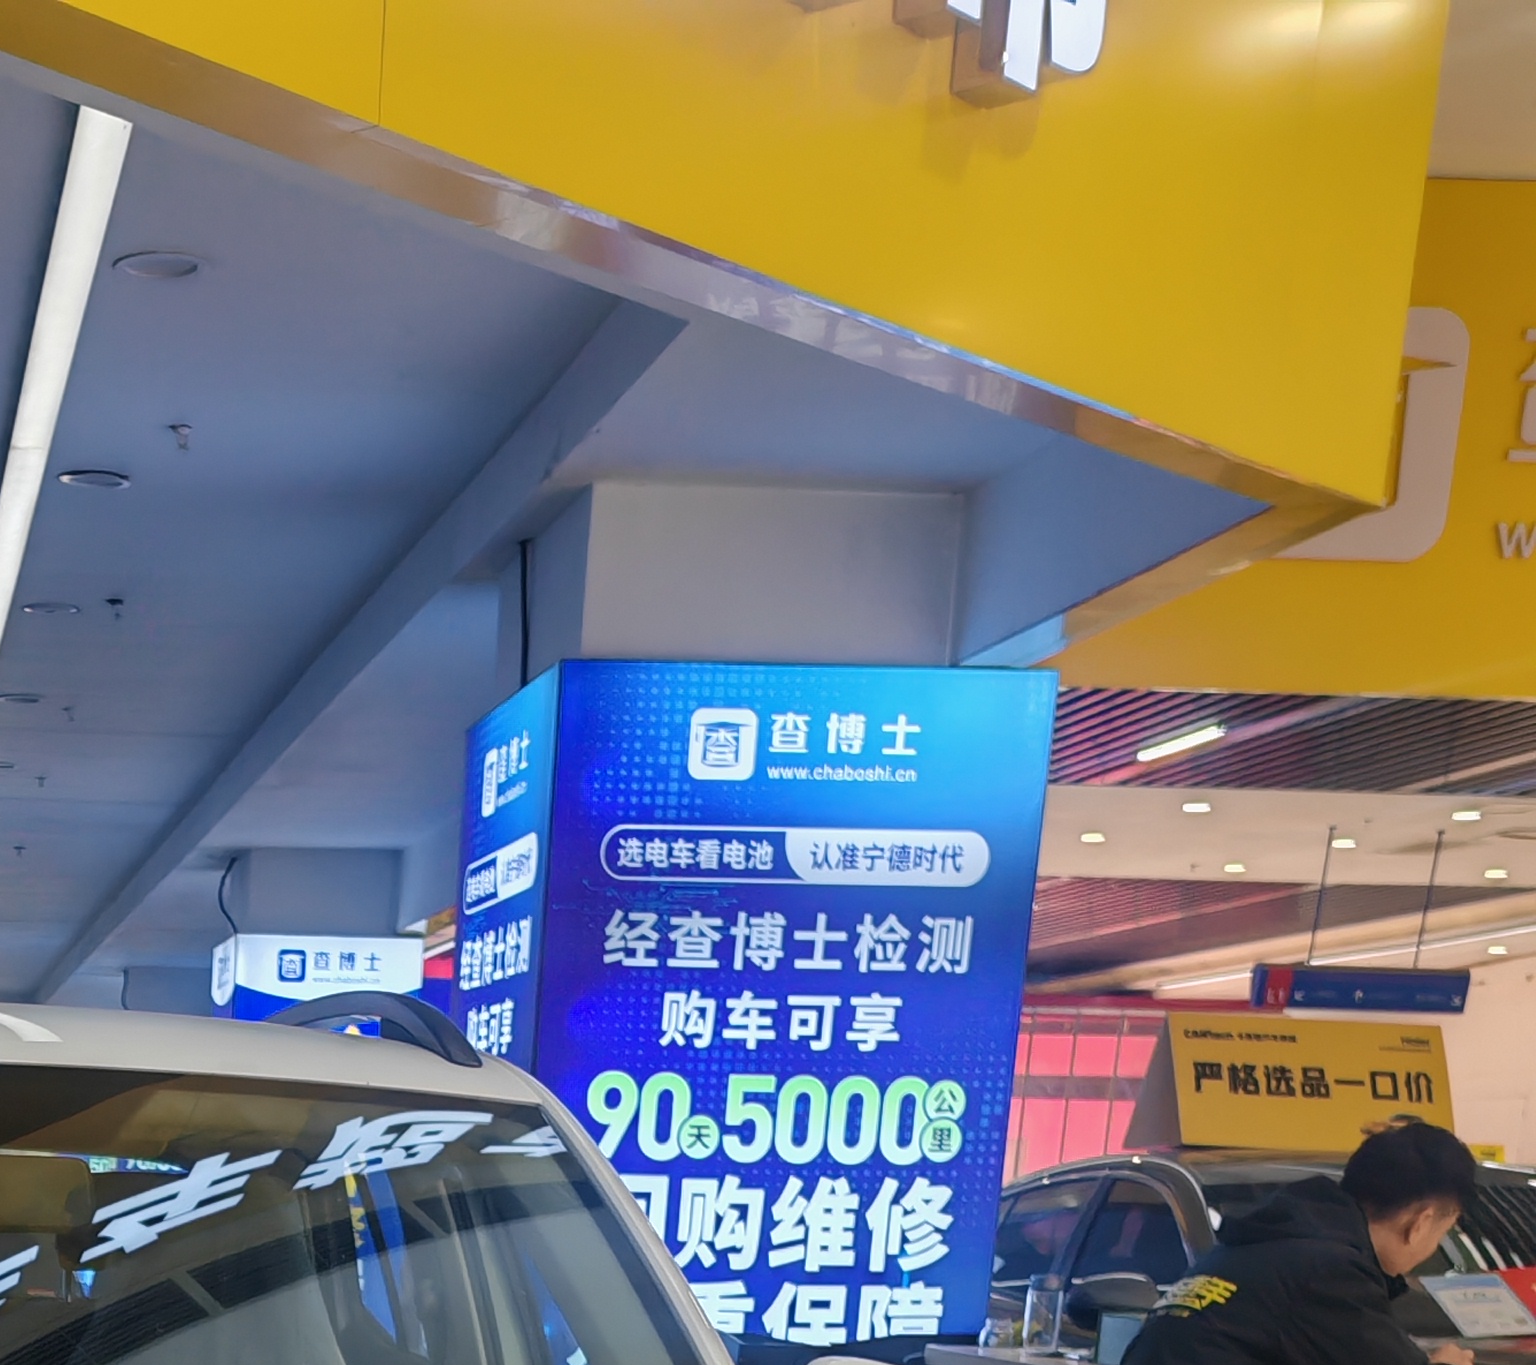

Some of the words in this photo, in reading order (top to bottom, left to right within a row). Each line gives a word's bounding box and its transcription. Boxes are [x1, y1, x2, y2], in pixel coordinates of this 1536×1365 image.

[768, 712, 921, 756] 查博士
[766, 764, 917, 783] www.chaboshi.cn
[616, 836, 775, 871] 选电车看电池
[809, 841, 965, 875] 认准宁德时代
[313, 951, 382, 972] 查博士
[602, 908, 974, 976] 经查博士检测
[657, 991, 904, 1052] 购车可享
[1193, 1061, 1434, 1104] 严格选品一口价
